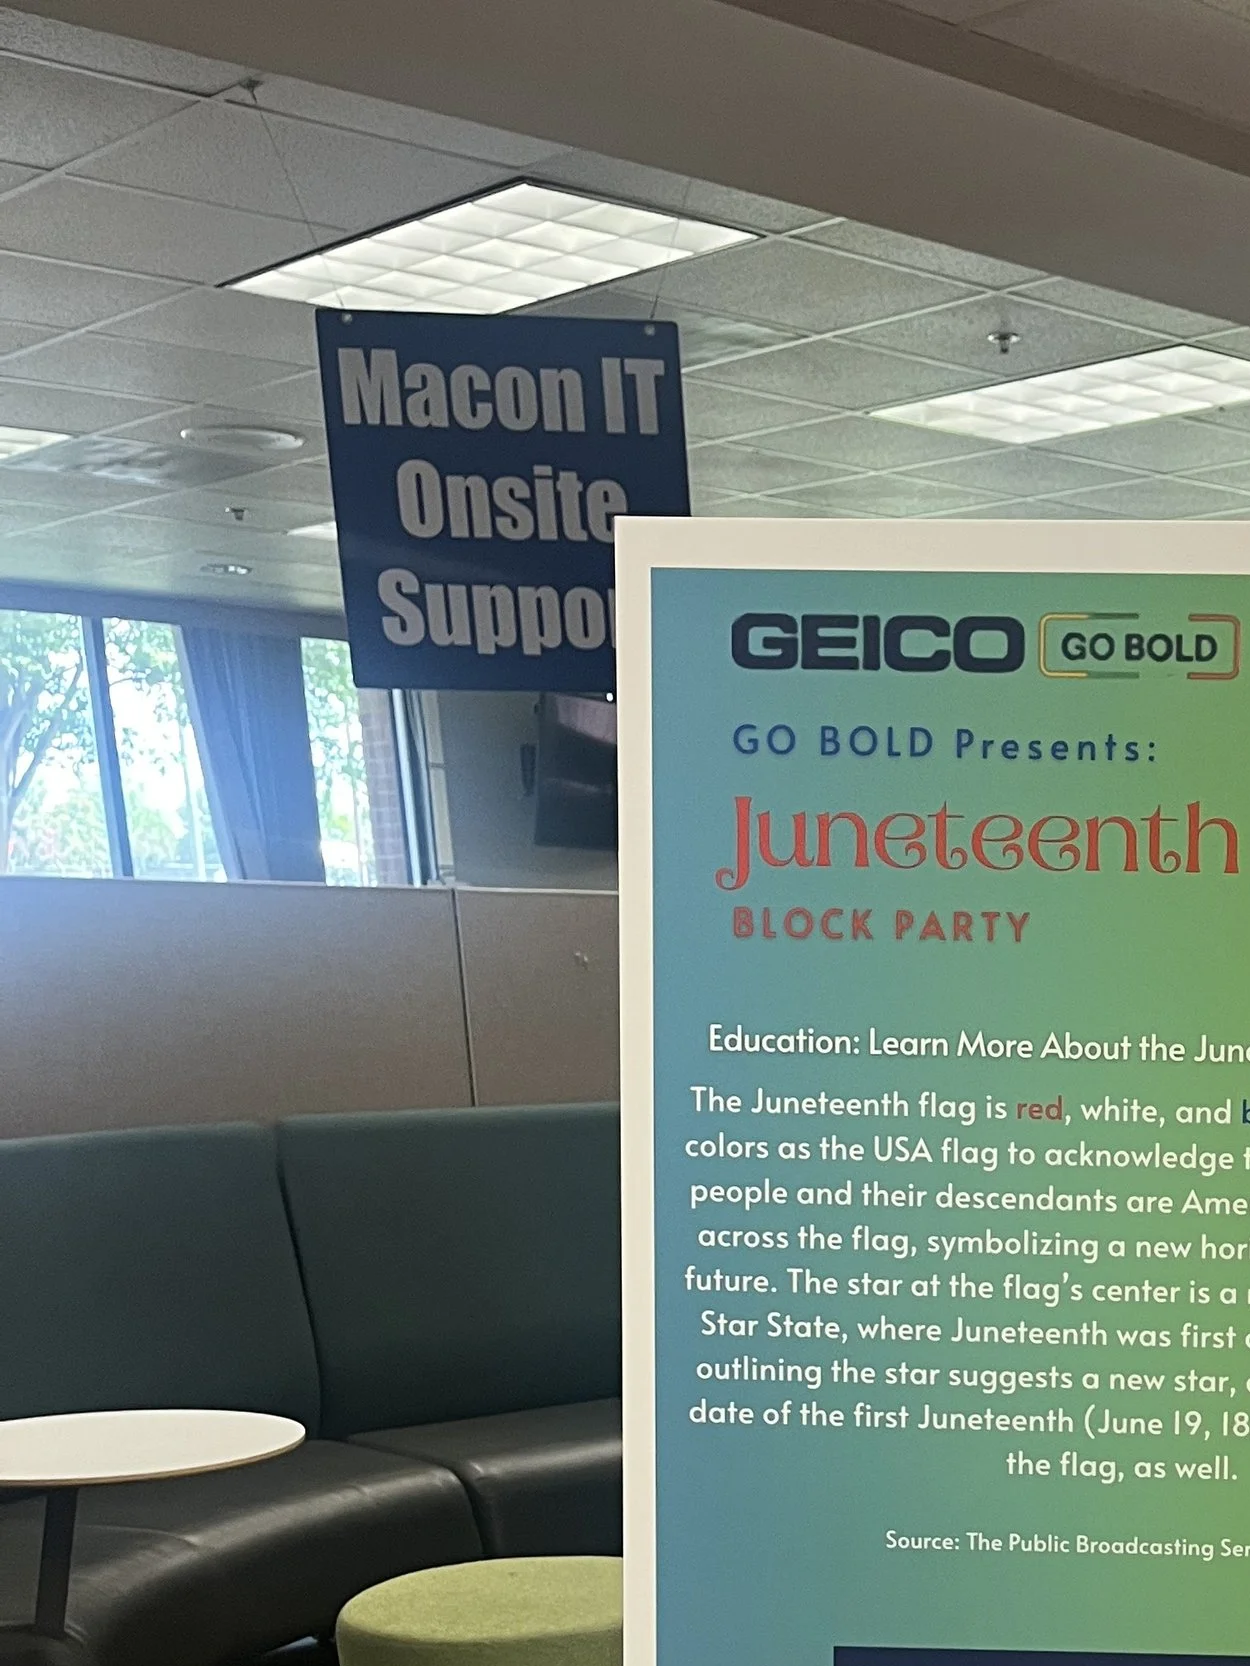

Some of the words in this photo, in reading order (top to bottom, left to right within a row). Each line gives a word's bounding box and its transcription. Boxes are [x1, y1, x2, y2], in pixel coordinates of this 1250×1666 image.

[337, 347, 586, 432] Macon
[602, 357, 665, 435] IT
[396, 459, 628, 543] Onsite
[377, 568, 616, 656] Suppo
[731, 613, 1025, 673] GEICO
[1061, 632, 1116, 662] GO
[1125, 633, 1217, 663] BOLD
[733, 724, 796, 756] GO
[820, 725, 933, 758] BOLD
[956, 728, 1157, 762] Presents:
[715, 796, 1239, 891] Juneteenth
[733, 906, 874, 940] BLOCK
[896, 909, 1031, 943] PARTY
[707, 1022, 859, 1055] Education:
[868, 1027, 949, 1057] Learn
[956, 1030, 1034, 1059] More
[1039, 1031, 1131, 1061] About
[1138, 1033, 1186, 1062] the
[689, 1085, 741, 1113] The
[750, 1087, 908, 1116] Juneteenth
[917, 1091, 975, 1125] flag
[985, 1094, 1007, 1119] is
[1015, 1094, 1071, 1125] red,
[1080, 1095, 1164, 1128] white,
[1175, 1098, 1231, 1124] and
[684, 1130, 768, 1158] colors
[777, 1141, 810, 1159] as
[819, 1134, 864, 1161] the
[874, 1135, 933, 1162] USA
[940, 1136, 997, 1171] flag
[1007, 1141, 1035, 1165] to
[1044, 1140, 1234, 1176] acknowledge
[689, 1177, 788, 1211] people
[796, 1179, 851, 1205] and
[861, 1180, 927, 1207] their
[935, 1182, 1117, 1212] descendants
[1126, 1195, 1173, 1213] are
[696, 1228, 788, 1248] across
[796, 1223, 842, 1250] the
[851, 1224, 916, 1259] flag,
[927, 1228, 1098, 1263] symbolizing
[1107, 1240, 1125, 1257] a
[1135, 1240, 1191, 1258] new
[684, 1265, 777, 1292] future.
[786, 1266, 839, 1294] The
[847, 1272, 903, 1296] star
[910, 1273, 940, 1296] at
[948, 1272, 993, 1298] the
[1091, 1279, 1180, 1302] center
[1189, 1279, 1210, 1303] is
[1219, 1287, 1236, 1304] a
[700, 1308, 758, 1336] Star
[767, 1311, 847, 1344] State,
[856, 1314, 941, 1341] where
[950, 1316, 1107, 1345] Juneteenth
[1116, 1329, 1171, 1347] was
[1180, 1322, 1236, 1348] first
[696, 1355, 821, 1389] outlining
[830, 1357, 875, 1383] the
[885, 1361, 940, 1385] star
[948, 1365, 1072, 1394] suggests
[1081, 1372, 1099, 1389] a
[1109, 1373, 1165, 1390] new
[1174, 1369, 1235, 1397] star,
[688, 1397, 754, 1424] date
[762, 1399, 792, 1425] of
[799, 1400, 844, 1426] the
[853, 1401, 909, 1428] first
[917, 1403, 1073, 1432] Juneteenth
[1084, 1403, 1162, 1439] (June
[1174, 1410, 1210, 1440] 19,
[1005, 1450, 1050, 1475] the
[1059, 1450, 1124, 1484] flag,
[1134, 1461, 1166, 1478] as
[1174, 1455, 1237, 1480] well.
[885, 1529, 960, 1551] Source:
[965, 1532, 1002, 1551] The
[1008, 1533, 1069, 1552] Public
[1076, 1534, 1213, 1561] Broadcasting
